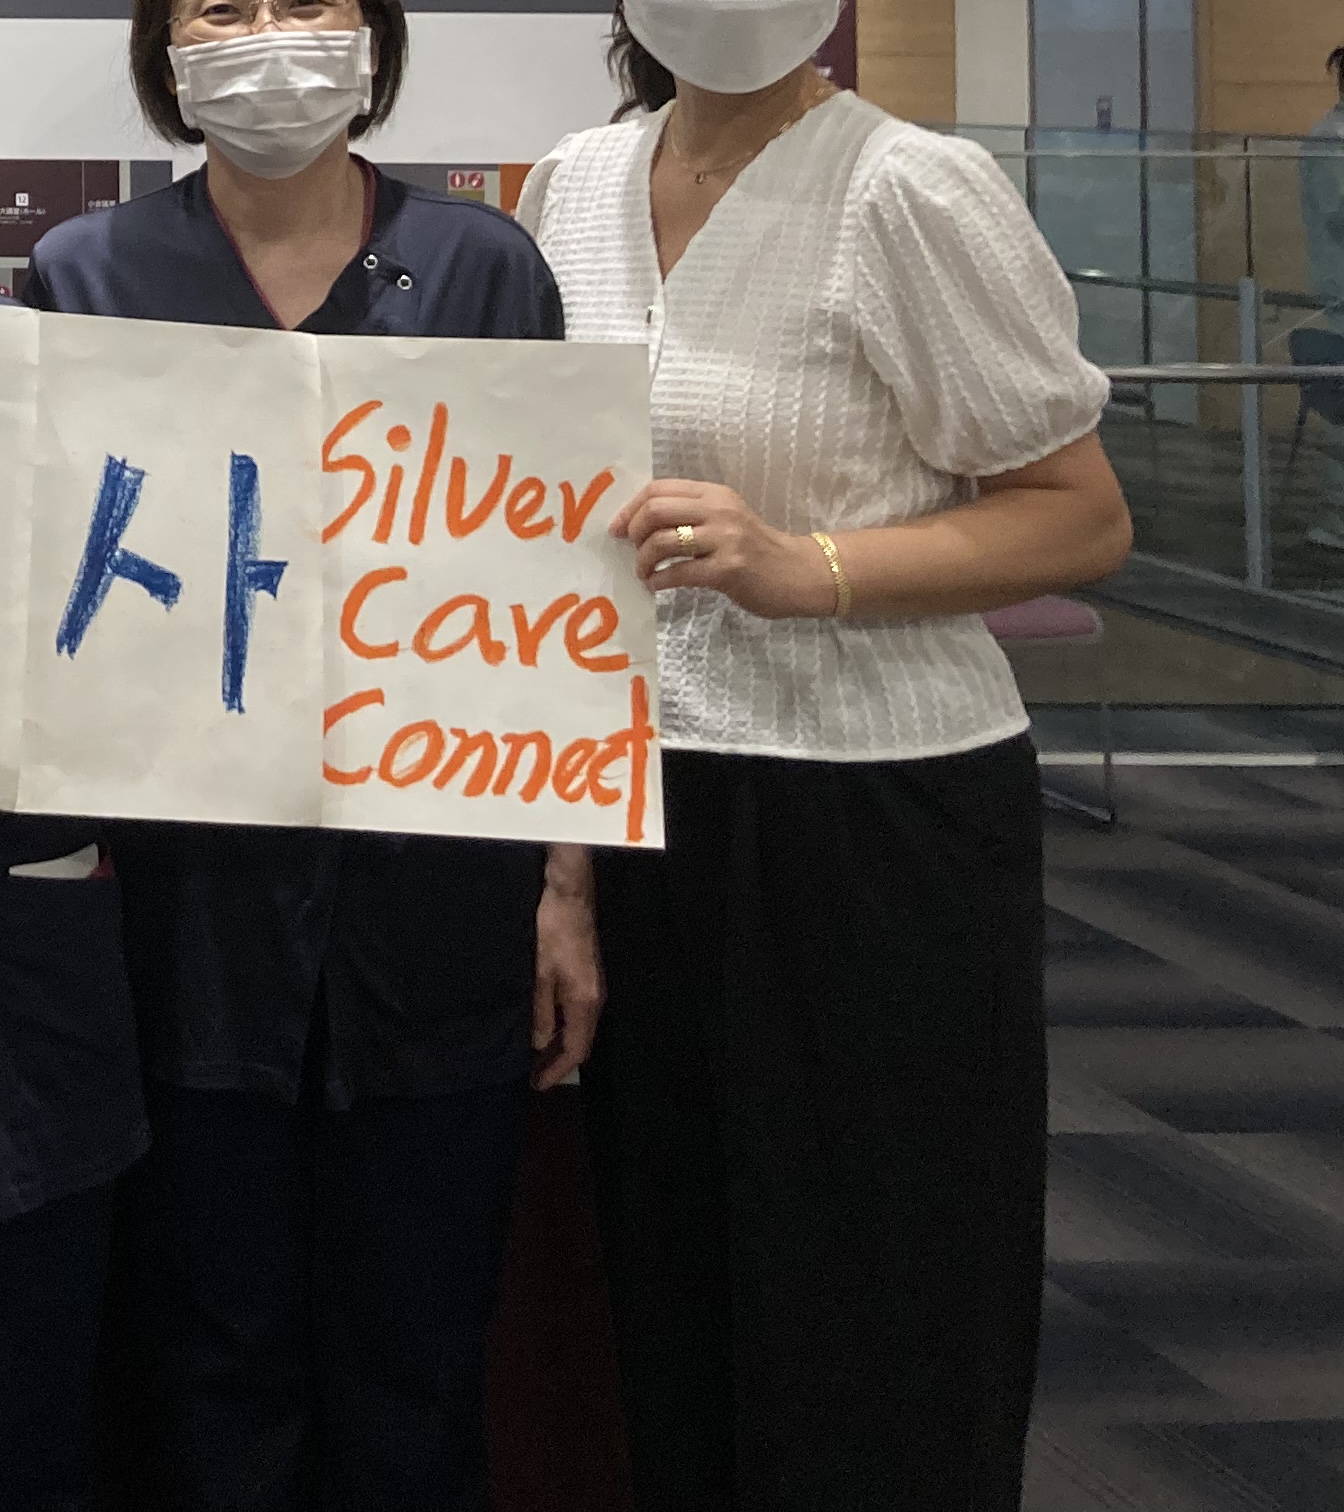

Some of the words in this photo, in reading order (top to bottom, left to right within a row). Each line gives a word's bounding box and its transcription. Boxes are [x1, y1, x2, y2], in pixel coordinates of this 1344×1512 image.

[321, 399, 616, 548] Silver
[339, 565, 633, 674] Care
[322, 674, 656, 843] Connect
